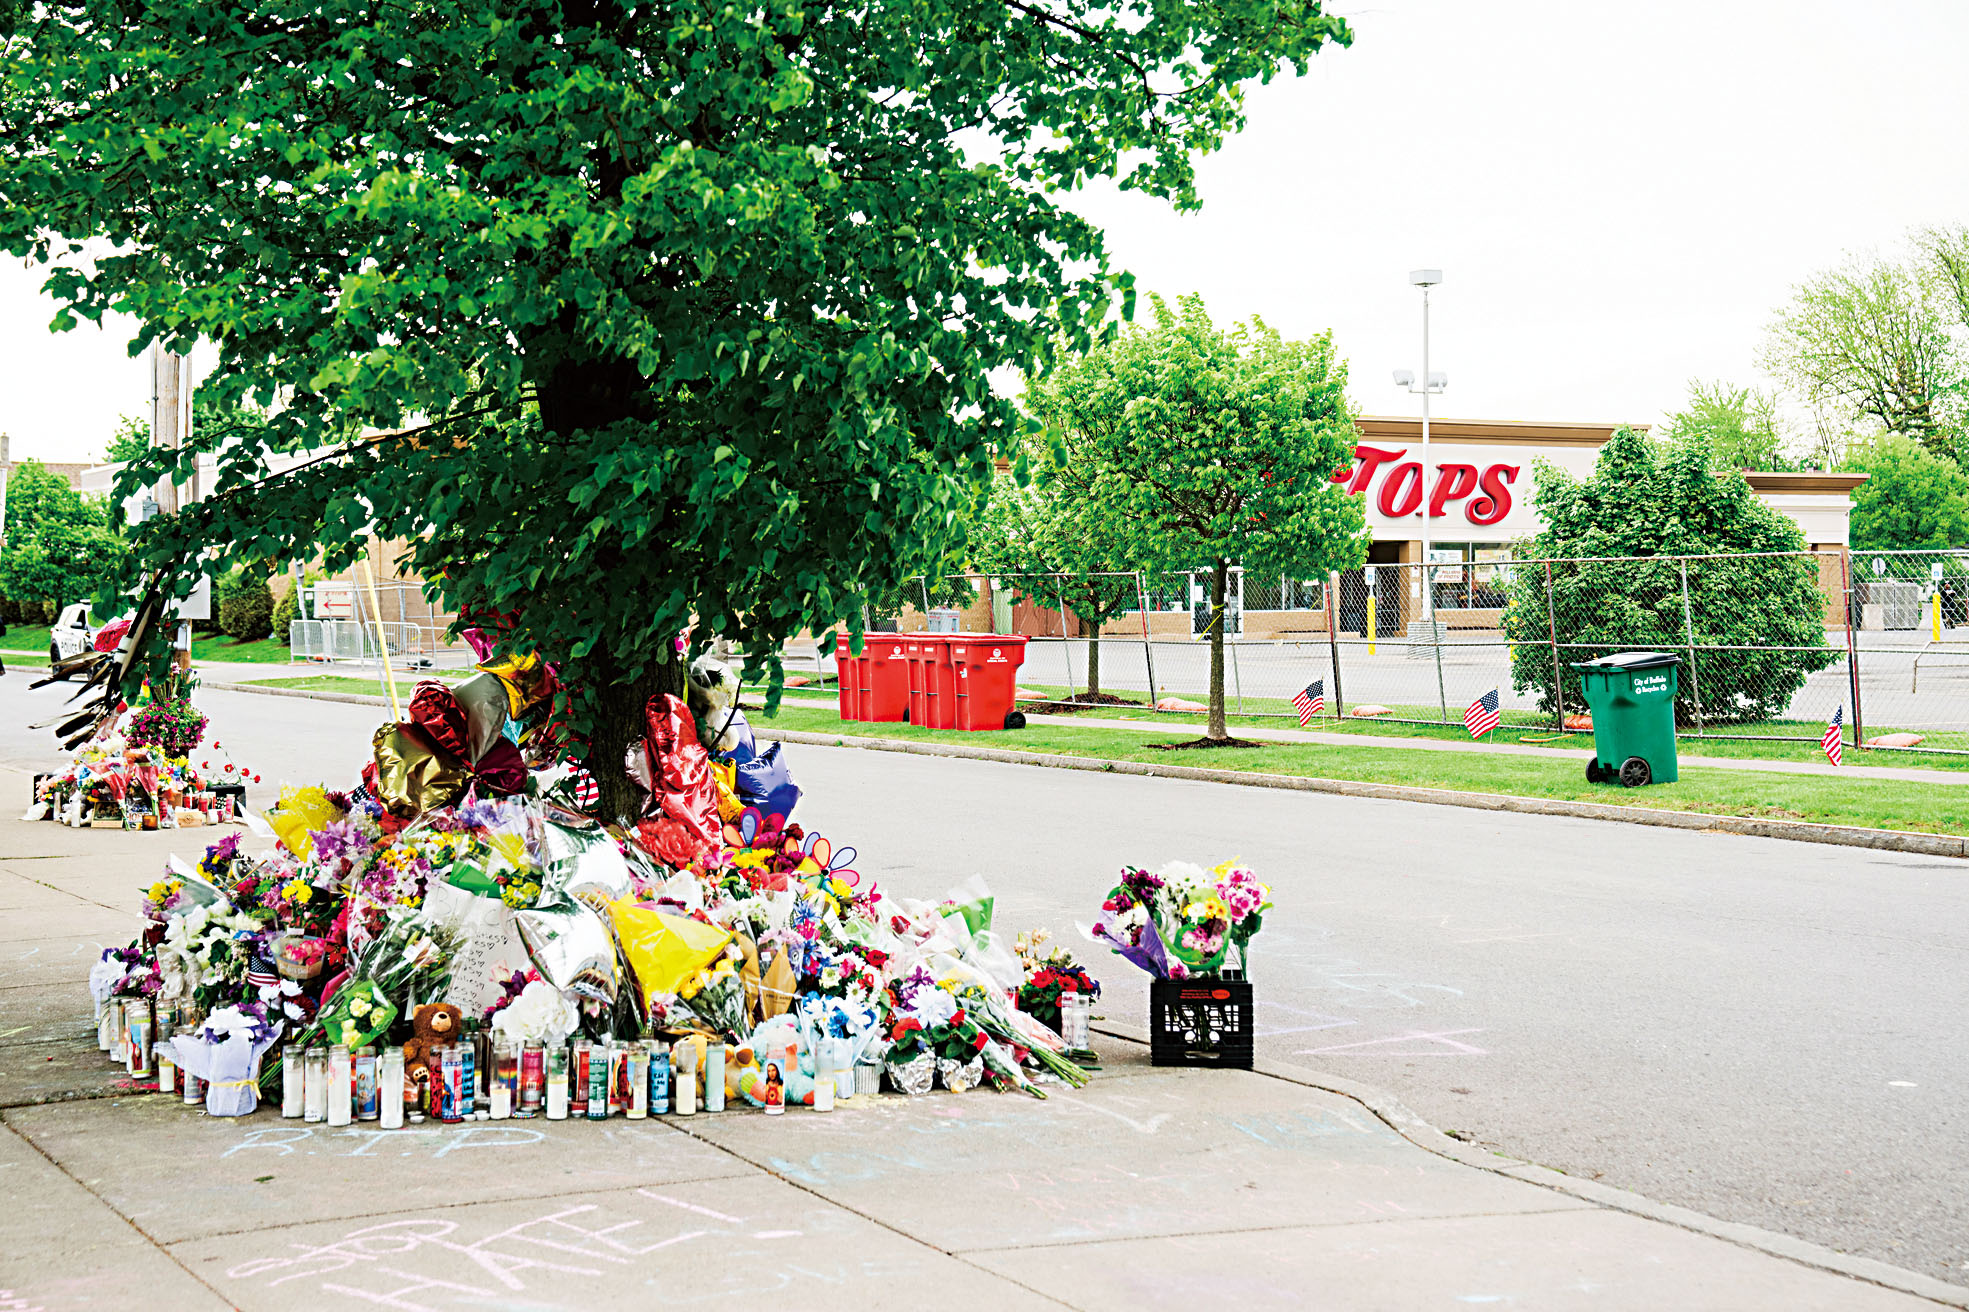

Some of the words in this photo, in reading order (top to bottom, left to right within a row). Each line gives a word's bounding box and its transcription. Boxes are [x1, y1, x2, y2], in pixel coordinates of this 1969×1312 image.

[1329, 446, 1521, 525] TOPS
[1634, 678, 1643, 686] City
[1649, 675, 1667, 684] Buffalo
[226, 1219, 471, 1286] STOP
